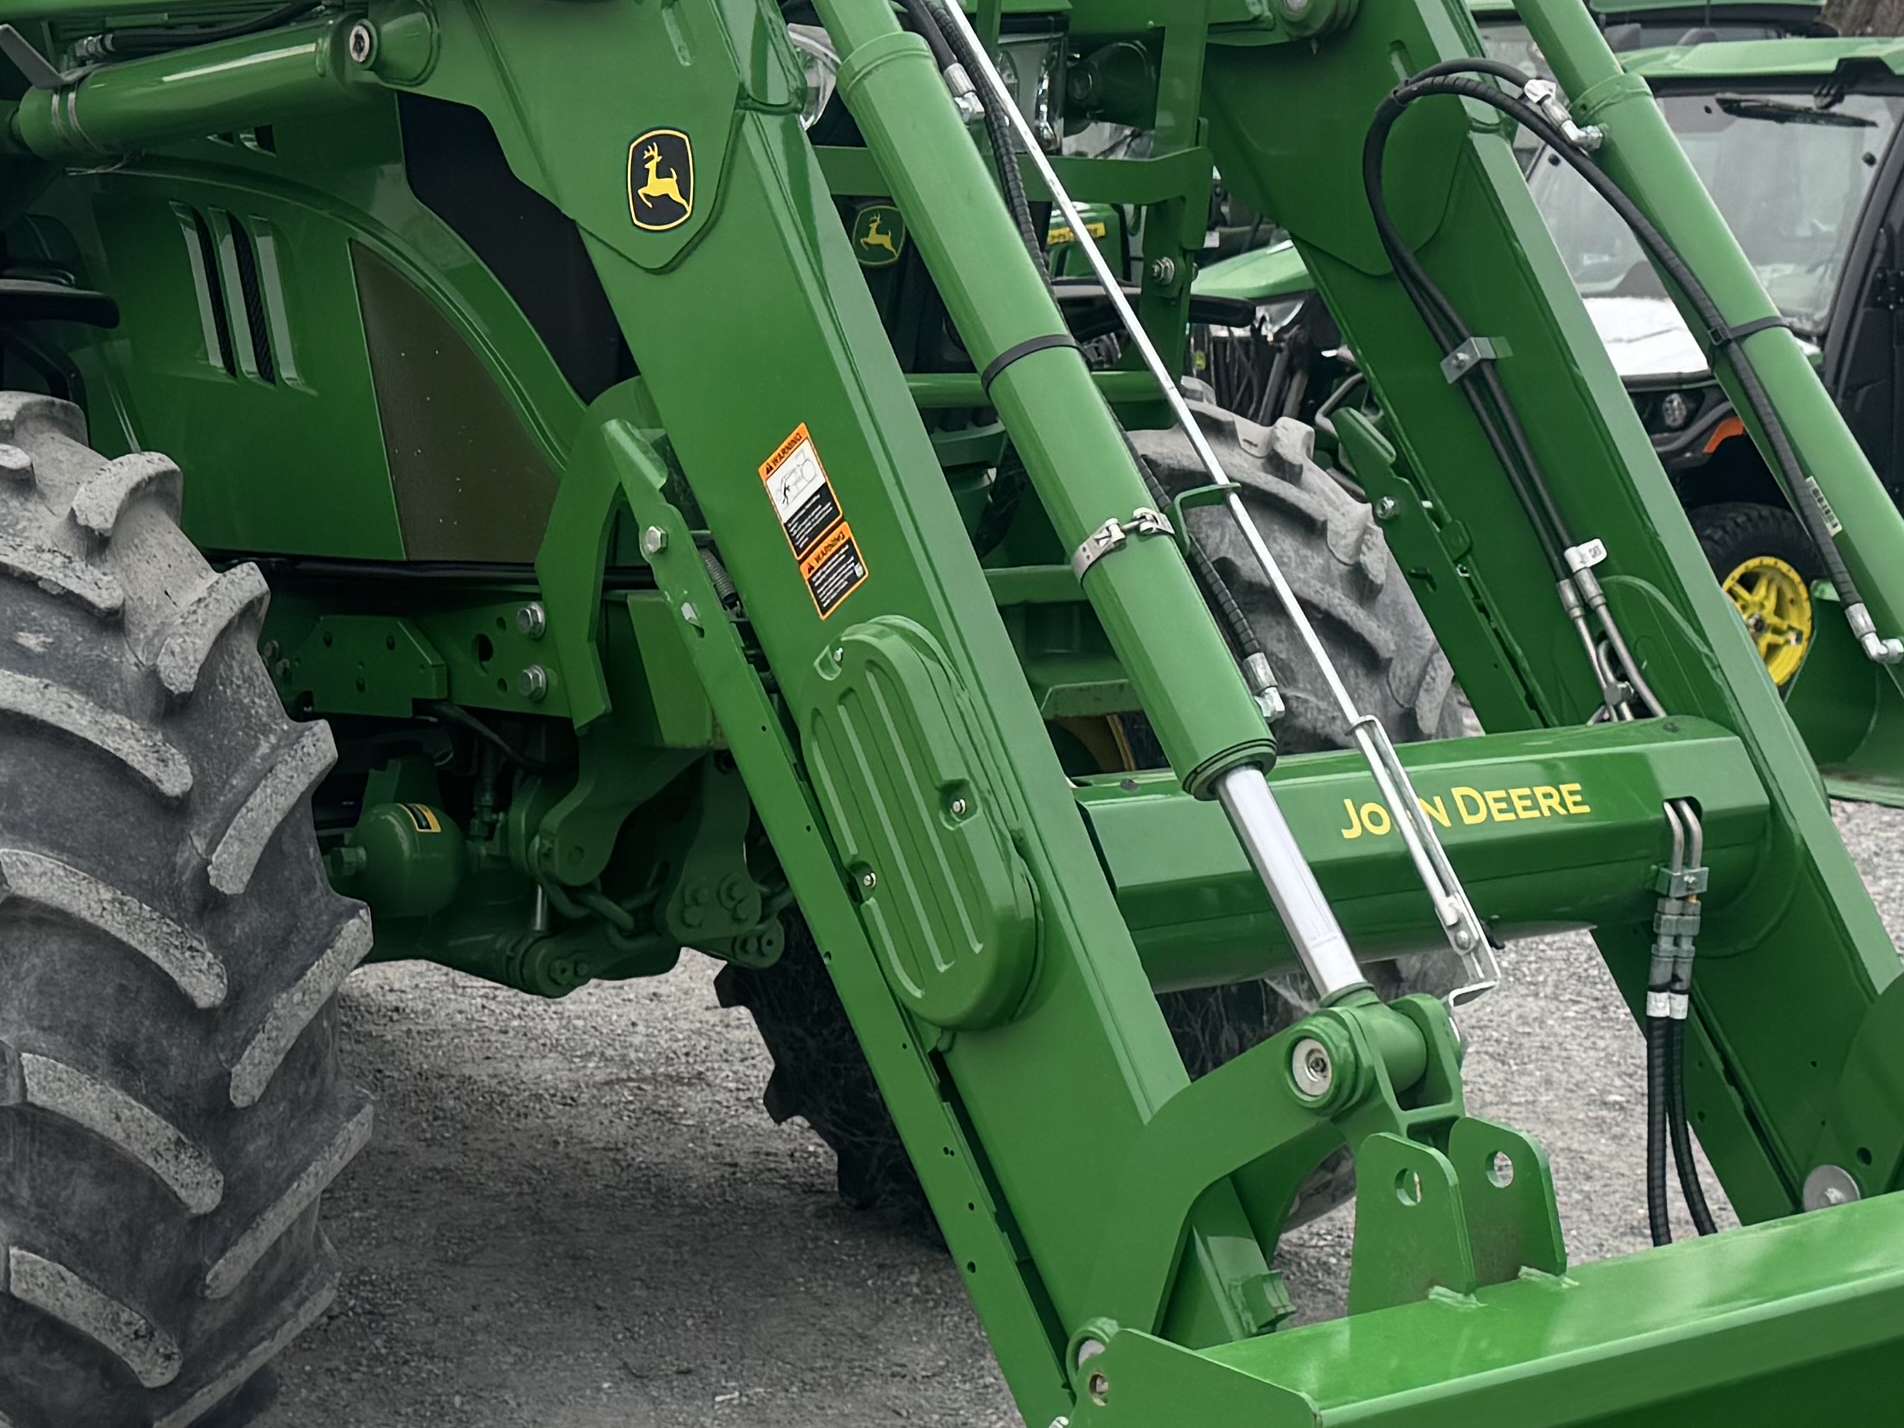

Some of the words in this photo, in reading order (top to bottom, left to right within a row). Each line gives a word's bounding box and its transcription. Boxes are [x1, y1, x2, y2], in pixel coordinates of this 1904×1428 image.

[770, 432, 802, 467] WARNING
[814, 531, 846, 564] WARNING
[1341, 795, 1452, 839] JON
[1451, 782, 1591, 825] DEERE
